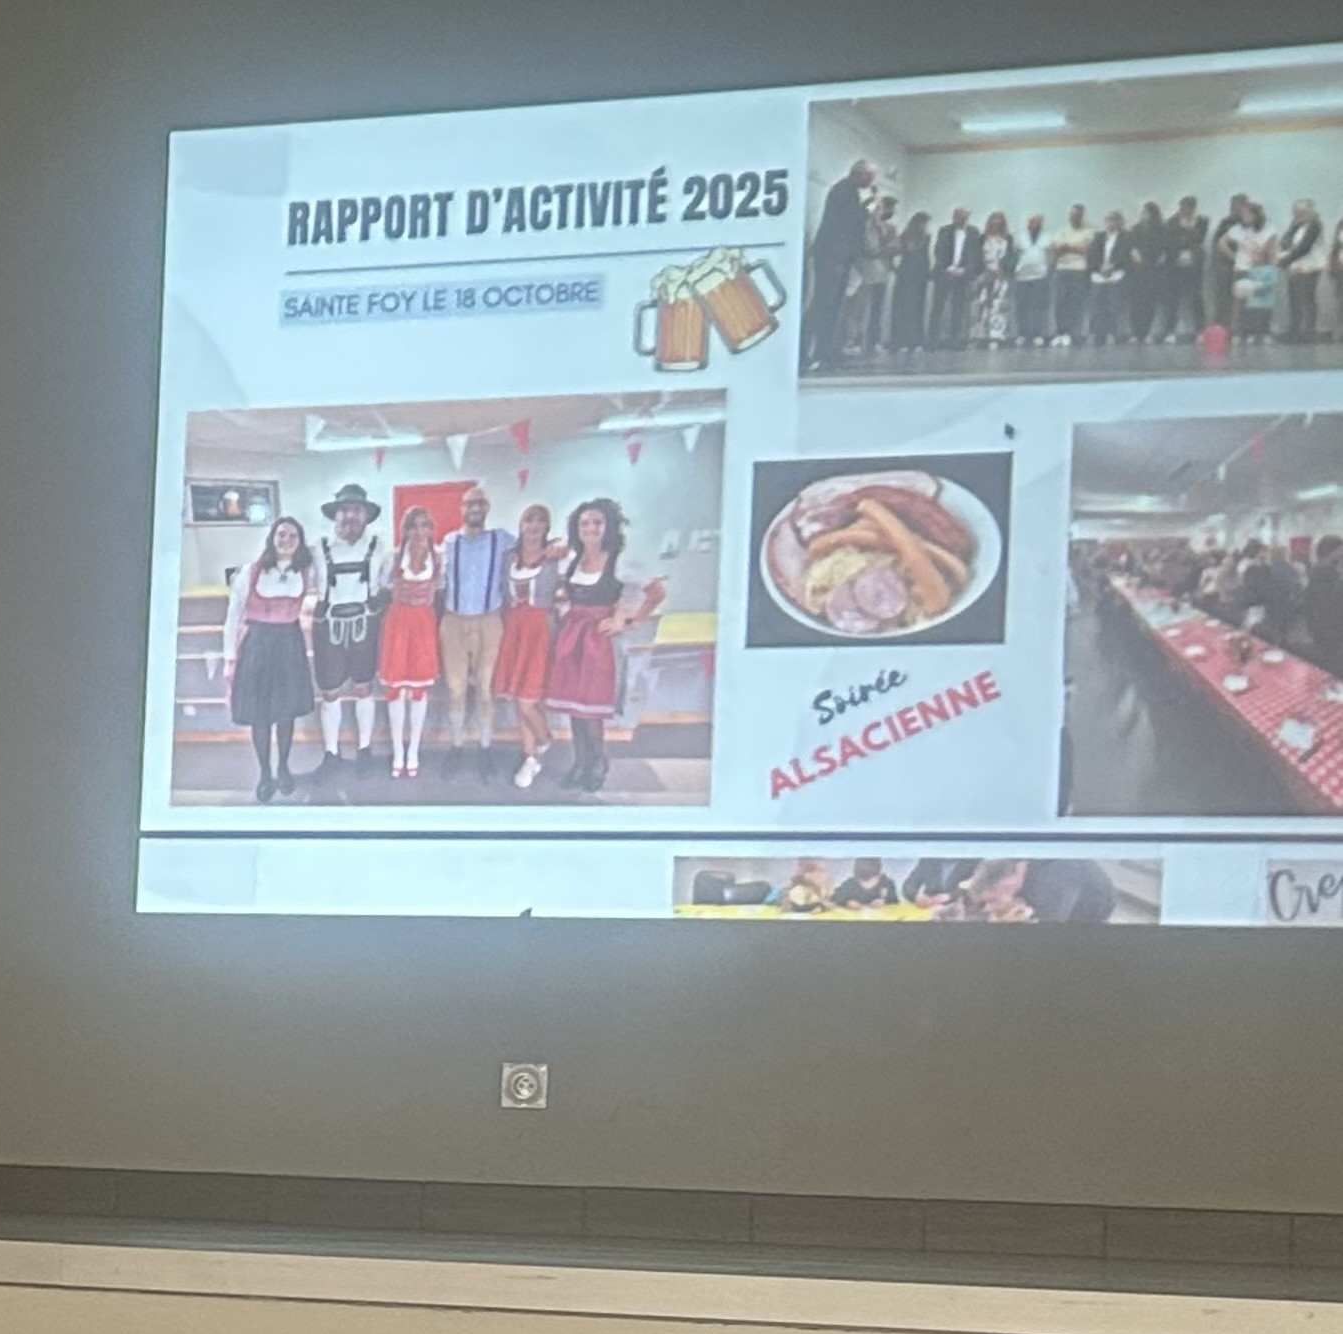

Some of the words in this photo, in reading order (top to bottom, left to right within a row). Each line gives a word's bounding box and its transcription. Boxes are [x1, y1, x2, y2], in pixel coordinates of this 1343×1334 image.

[287, 190, 454, 246] RAPPORT
[466, 166, 668, 235] D'ACTIVITÉ
[683, 169, 789, 221] 2025
[284, 294, 359, 318] SAINTE
[367, 291, 416, 313] FOY
[422, 287, 447, 312] LE
[455, 287, 476, 309] 18
[482, 280, 600, 308] OCTOBRE
[812, 669, 908, 725] Soirée
[770, 670, 1002, 799] ALSACIENNE
[1270, 868, 1343, 922] Cre
